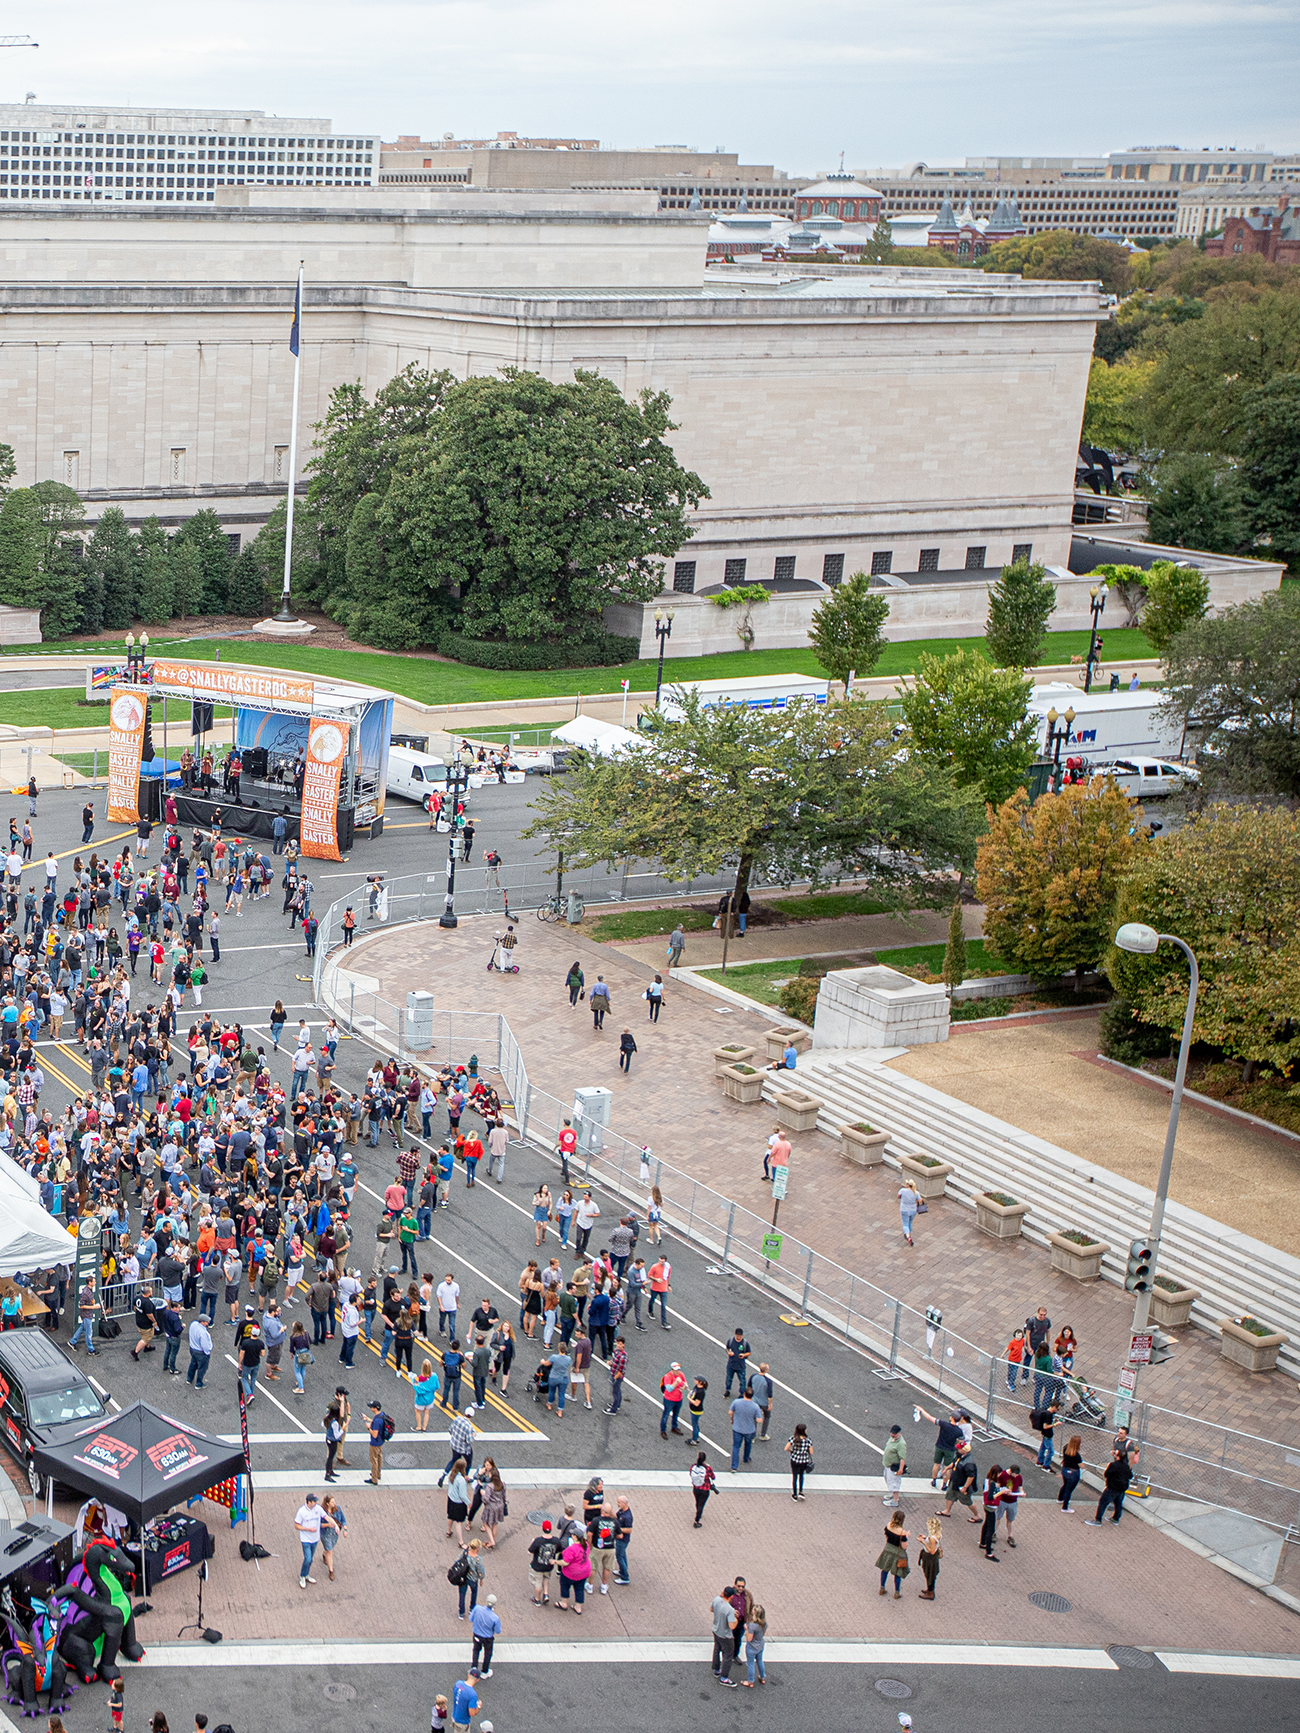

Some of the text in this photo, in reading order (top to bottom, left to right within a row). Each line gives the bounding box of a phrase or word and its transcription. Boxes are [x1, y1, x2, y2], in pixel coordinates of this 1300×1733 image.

[177, 668, 288, 698] @SNALLYGASTERDC
[110, 730, 140, 745] SNALLY
[109, 752, 138, 767] GASTER
[306, 761, 338, 778] SNALLY
[110, 773, 136, 789] SNALLY
[305, 784, 335, 801] GASTER
[109, 794, 135, 811] GASTER
[303, 806, 333, 823] SNALLY
[303, 829, 334, 845] GASTER
[91, 1433, 139, 1463] ESPN
[145, 1433, 192, 1463] ESPN
